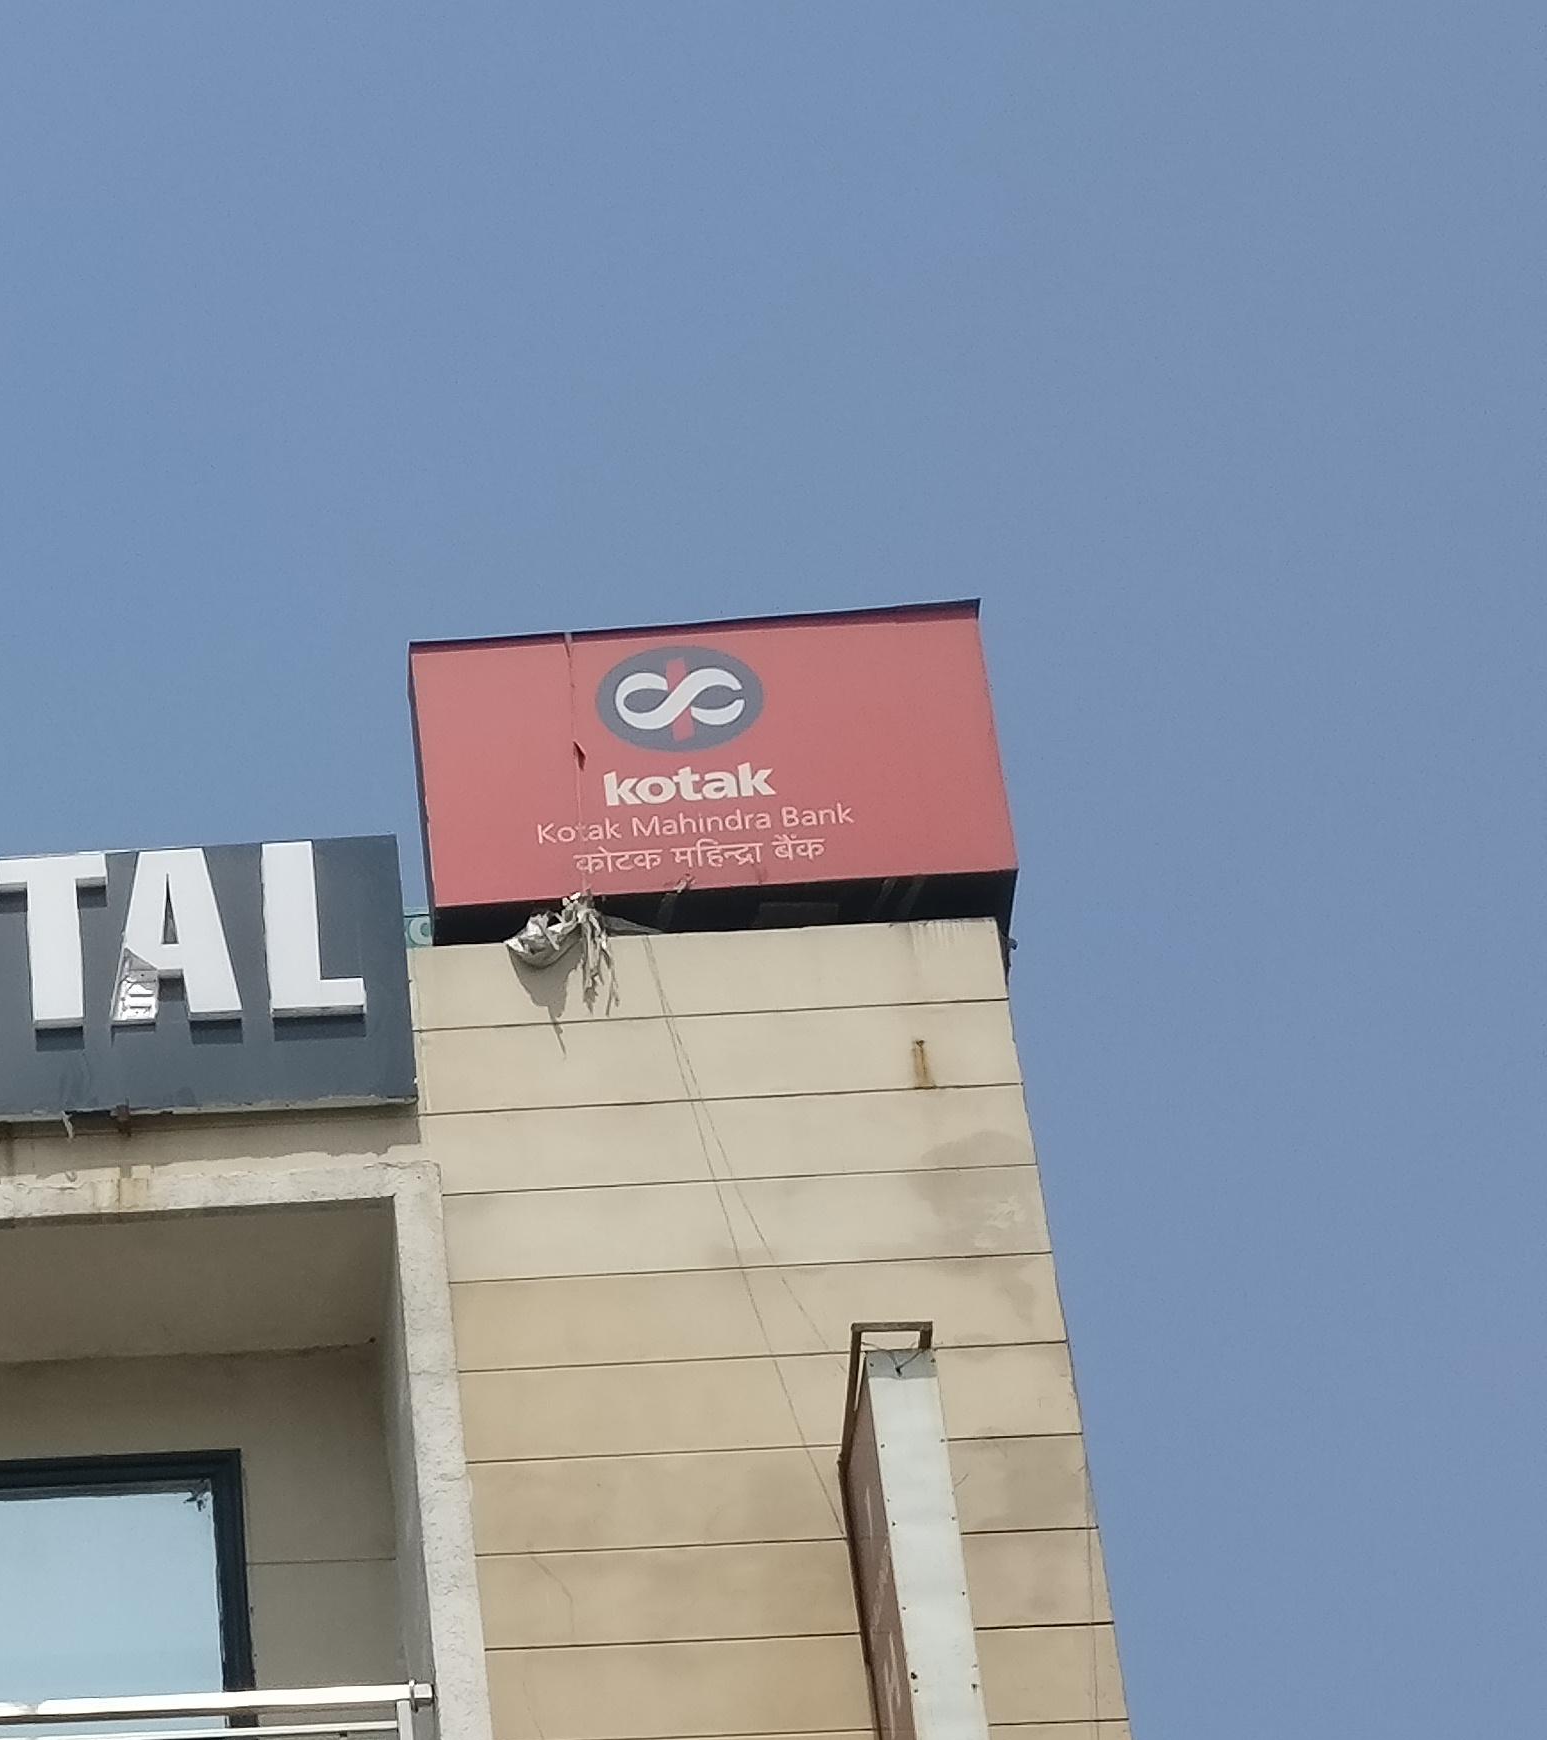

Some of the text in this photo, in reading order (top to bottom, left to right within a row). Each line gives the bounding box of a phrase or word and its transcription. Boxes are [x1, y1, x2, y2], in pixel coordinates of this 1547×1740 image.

[603, 761, 777, 807] kotak
[631, 807, 773, 838] Mahindra
[781, 801, 855, 828] Bank
[572, 845, 662, 875] कोटक
[771, 833, 826, 862] बैंक
